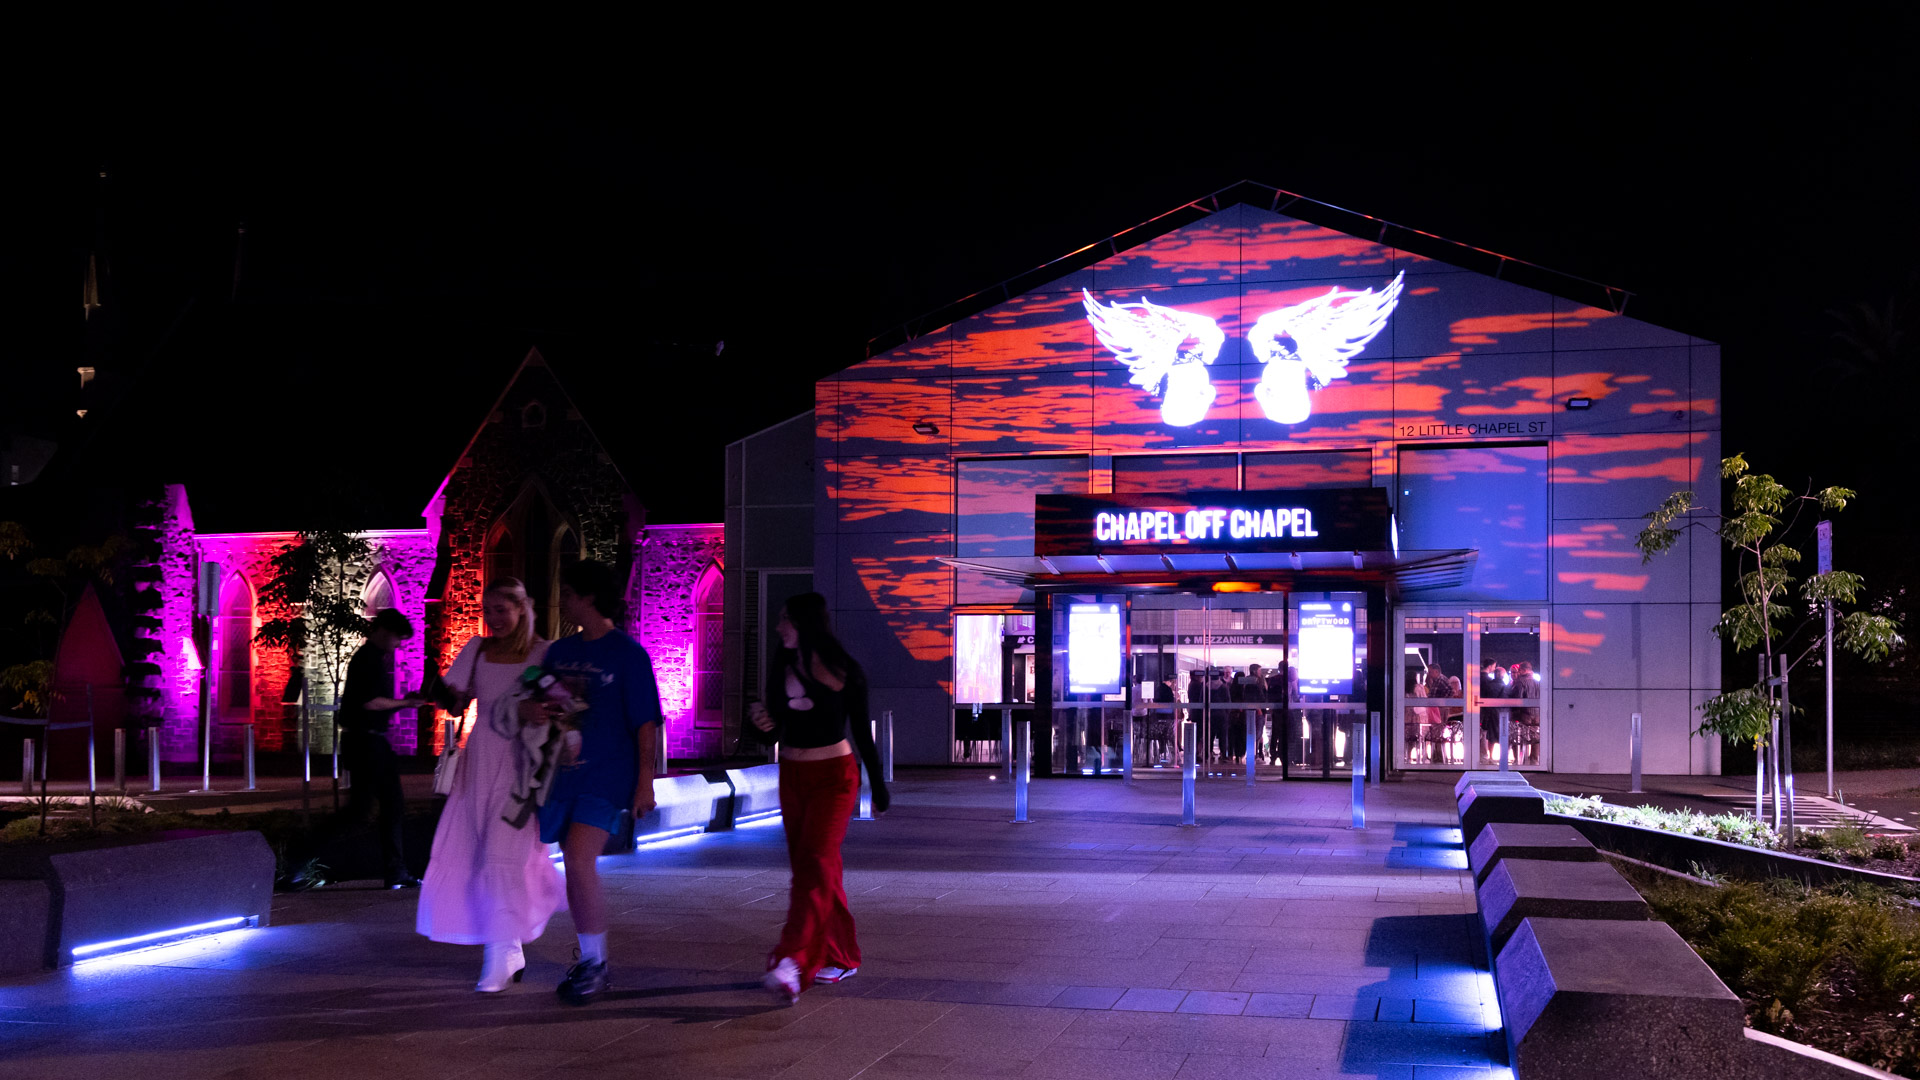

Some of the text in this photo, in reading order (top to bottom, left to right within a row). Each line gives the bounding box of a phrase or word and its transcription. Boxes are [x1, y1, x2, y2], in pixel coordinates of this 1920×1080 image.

[1400, 421, 1547, 437] 12 LITTLE CHAPEL ST
[1096, 508, 1318, 541] CHAPEL OFF CHAPEL
[1301, 617, 1350, 625] DRIFTWOOD
[1194, 636, 1254, 645] MEZZANINE
